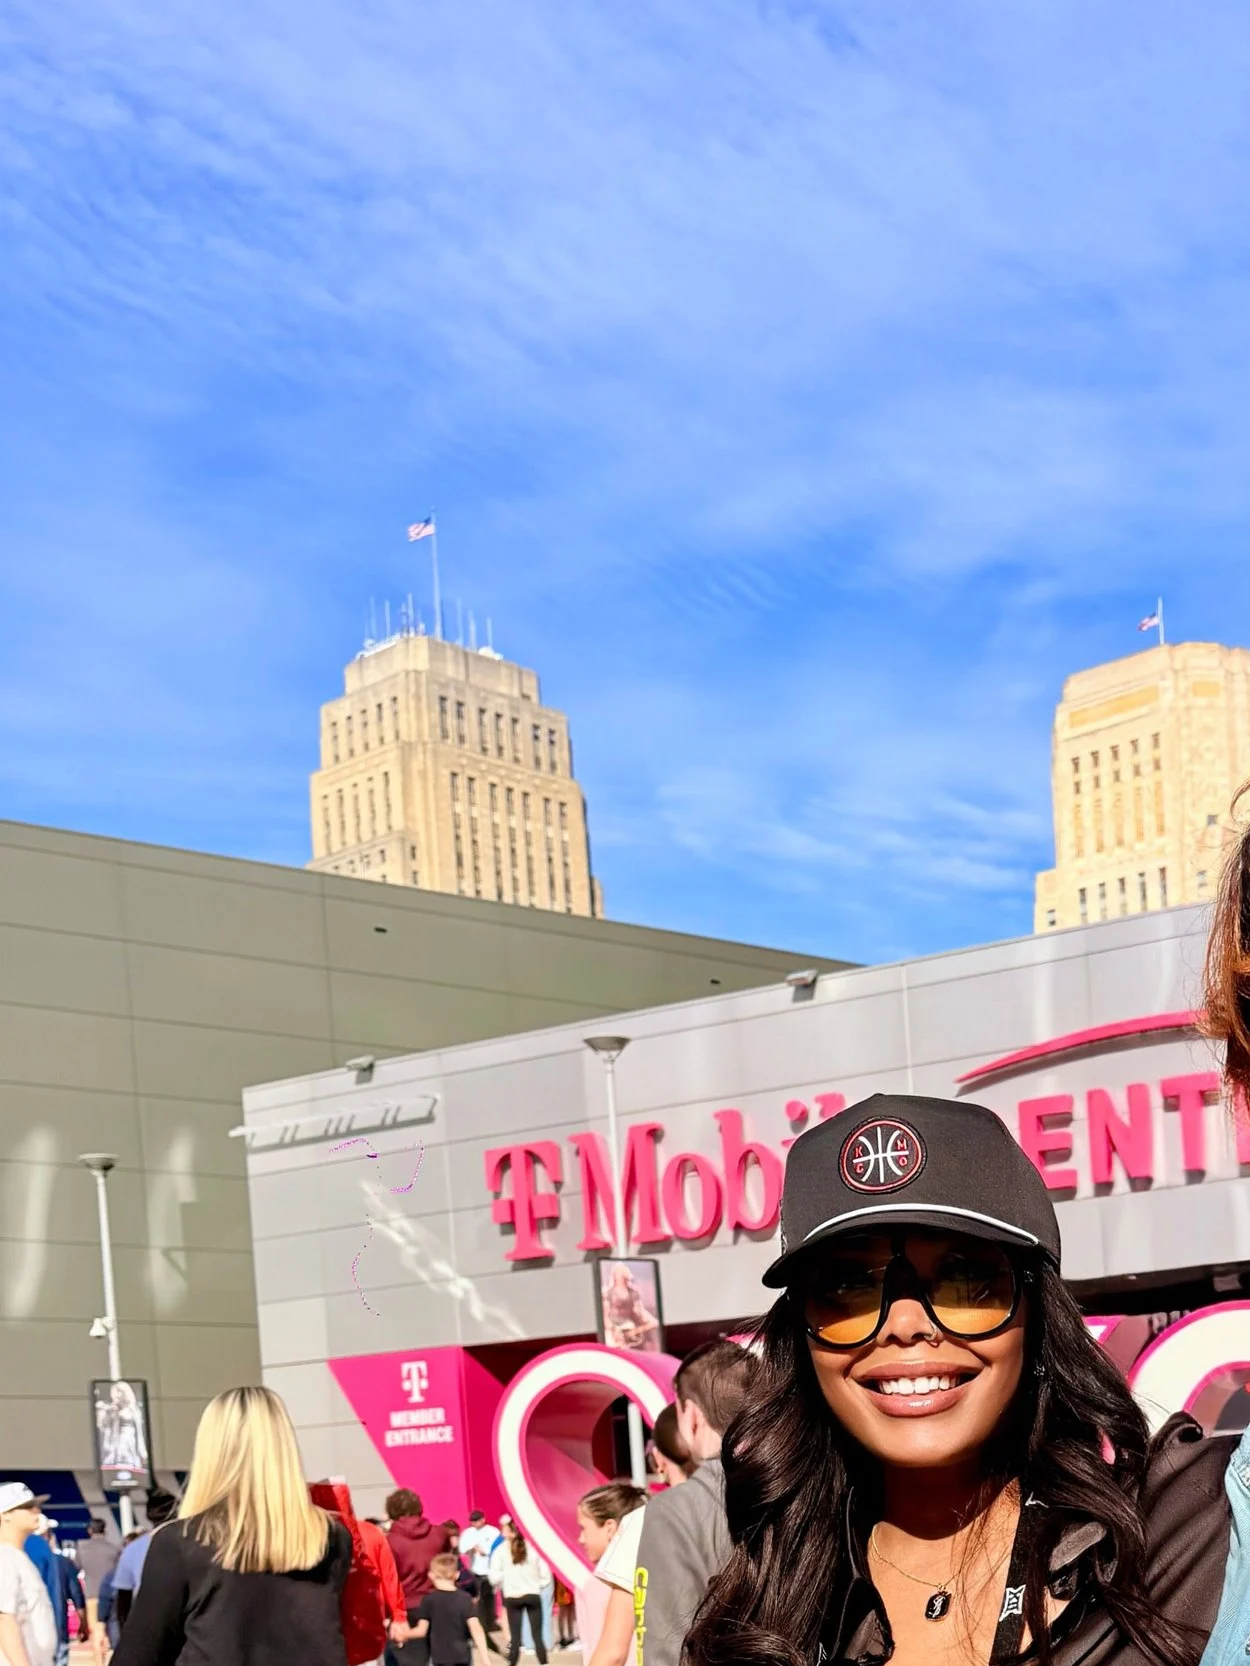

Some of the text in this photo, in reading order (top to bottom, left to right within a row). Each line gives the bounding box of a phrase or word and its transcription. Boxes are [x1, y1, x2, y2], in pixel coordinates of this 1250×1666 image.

[485, 1140, 563, 1261] T
[401, 1360, 429, 1403] T
[389, 1407, 446, 1429] MEMBER
[385, 1425, 454, 1447] ENTRANCE
